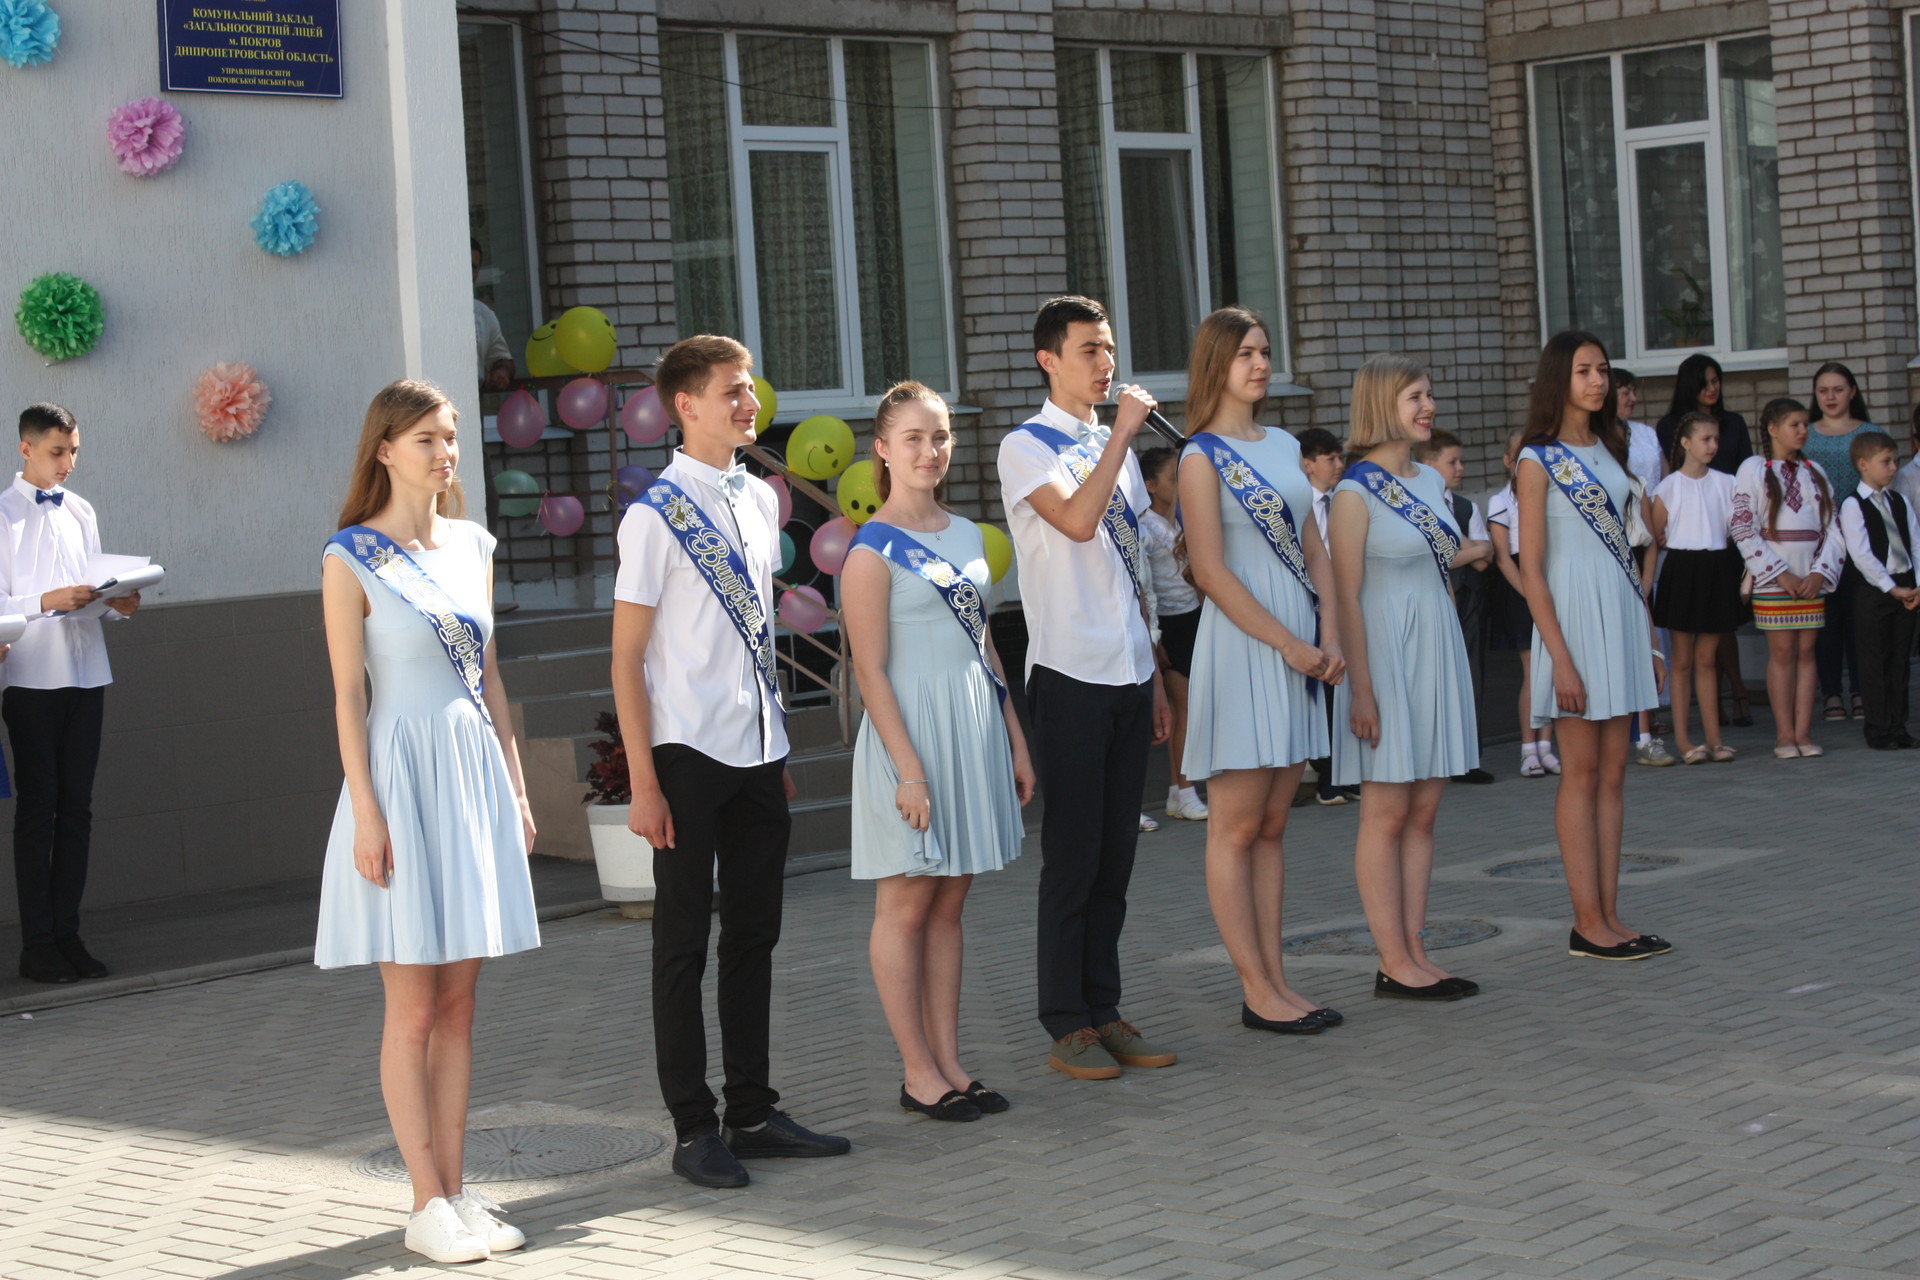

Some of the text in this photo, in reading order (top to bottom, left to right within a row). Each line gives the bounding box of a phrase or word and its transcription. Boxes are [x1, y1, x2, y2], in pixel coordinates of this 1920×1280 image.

[193, 8, 314, 26] КОМУНАЛЬНИЙ ЗАКЛАД
[184, 20, 323, 38] «ЗАГАЛЬНООСВІТНІЙ ЛІЦЕЙ
[229, 36, 281, 48] м. ПОКРОВ
[174, 46, 334, 63] ДНІПРОПЕТРОВСЬКОЇ ОБЛАСТІ»
[208, 76, 256, 85] ПОКРОВСЬКОЇ
[258, 78, 286, 86] МІСЬКОЇ
[266, 69, 291, 77] ОСВІТИ
[686, 528, 766, 650] Випускник
